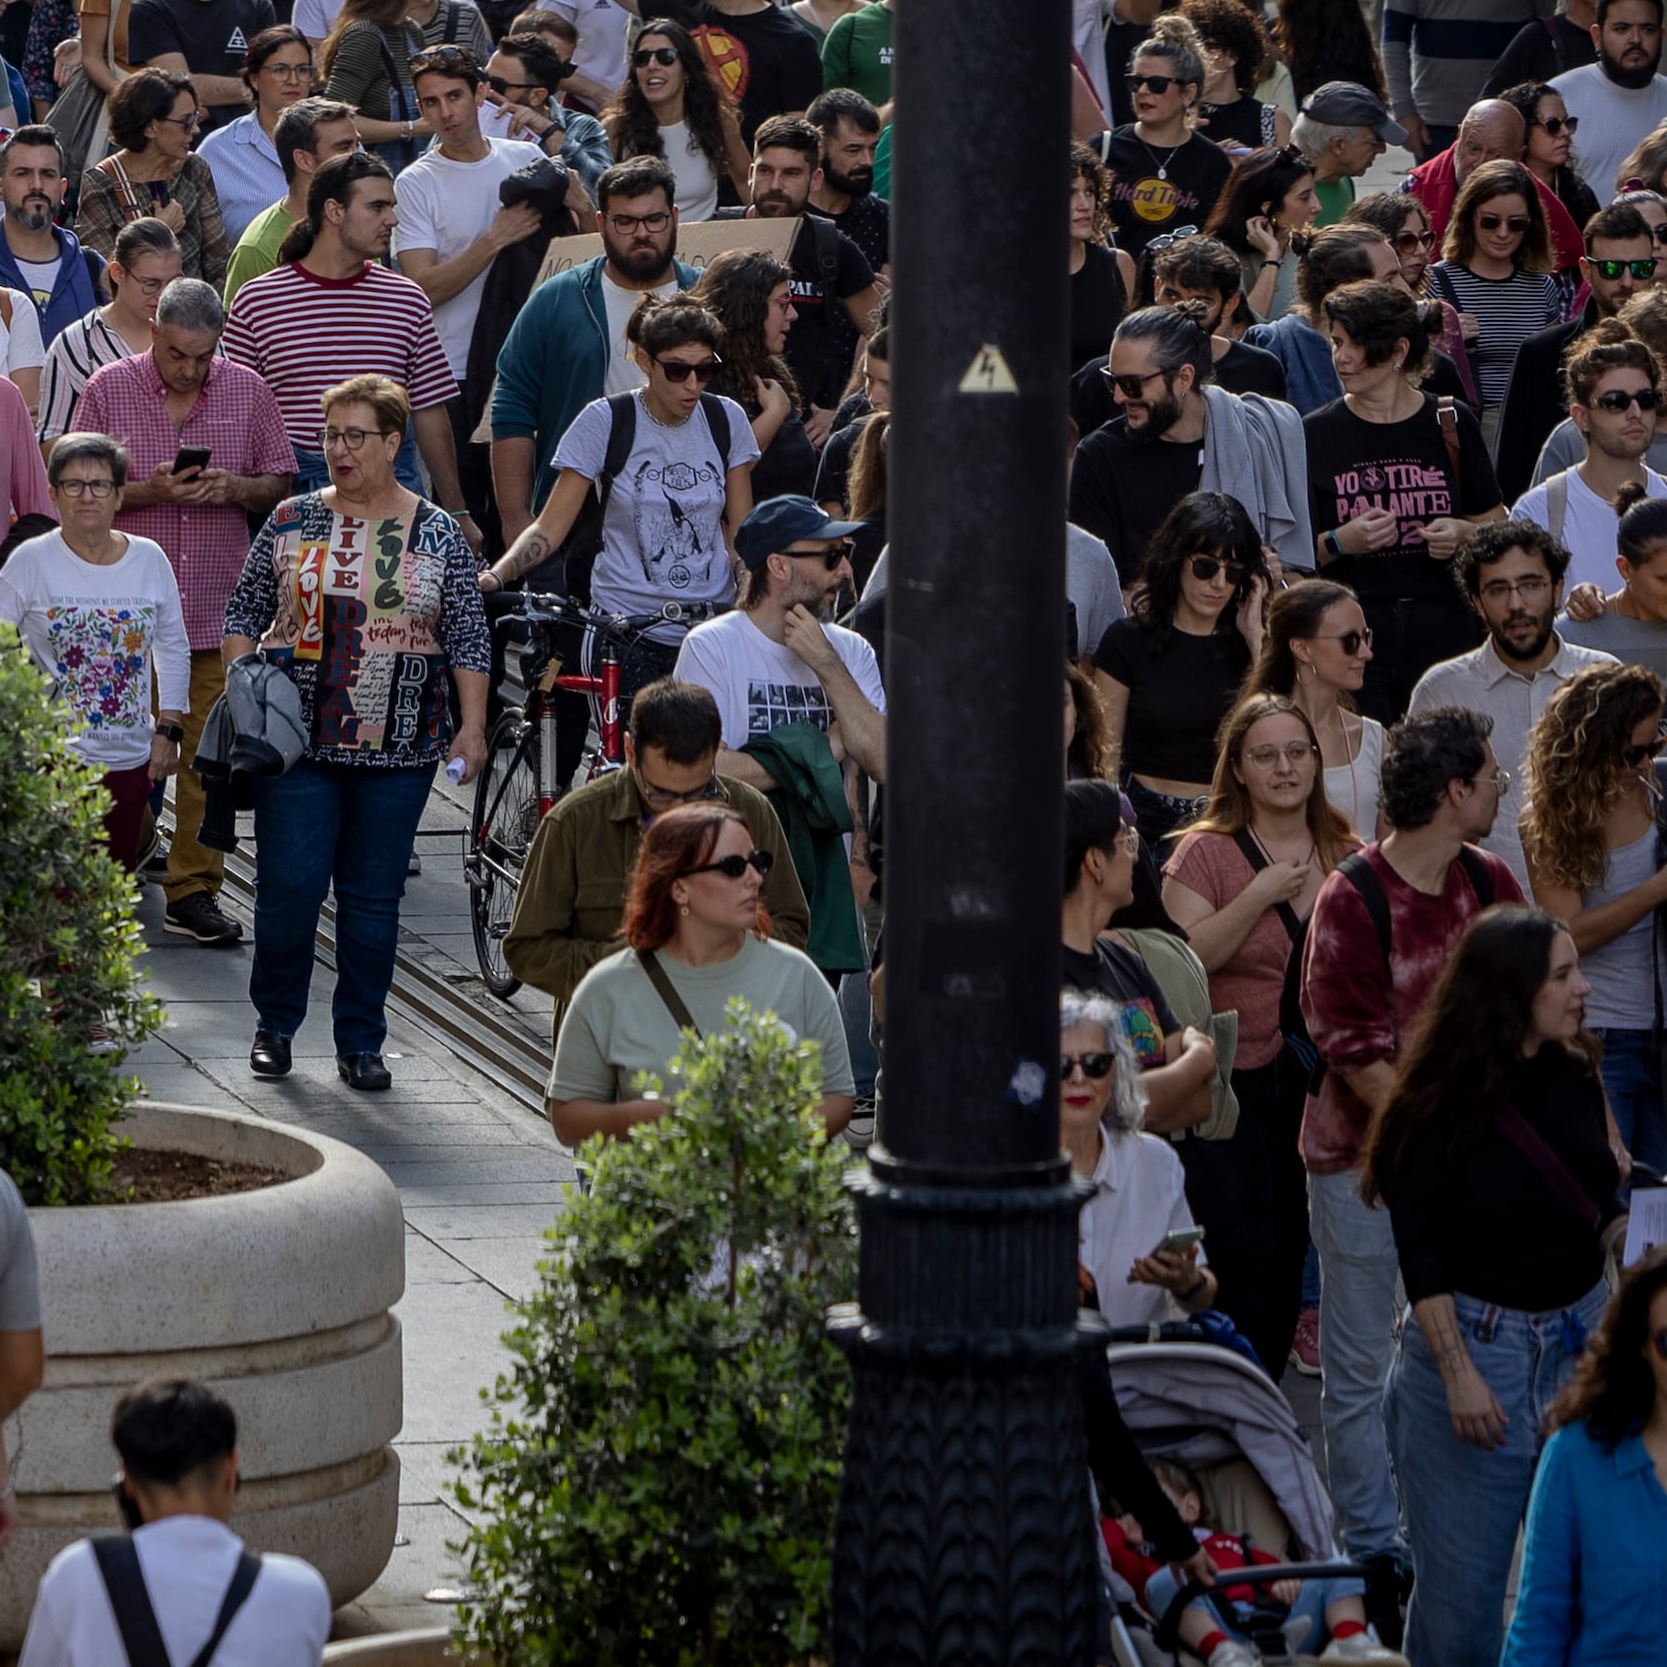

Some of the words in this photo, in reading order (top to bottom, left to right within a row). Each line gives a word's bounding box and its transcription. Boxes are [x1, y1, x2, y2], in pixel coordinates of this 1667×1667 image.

[1113, 182, 1158, 204] Hard
[1334, 471, 1360, 496] YO
[1384, 465, 1447, 490] TIRÉ
[331, 515, 365, 590] LIVE
[300, 546, 323, 643] LOVE
[320, 597, 368, 746] DREAM
